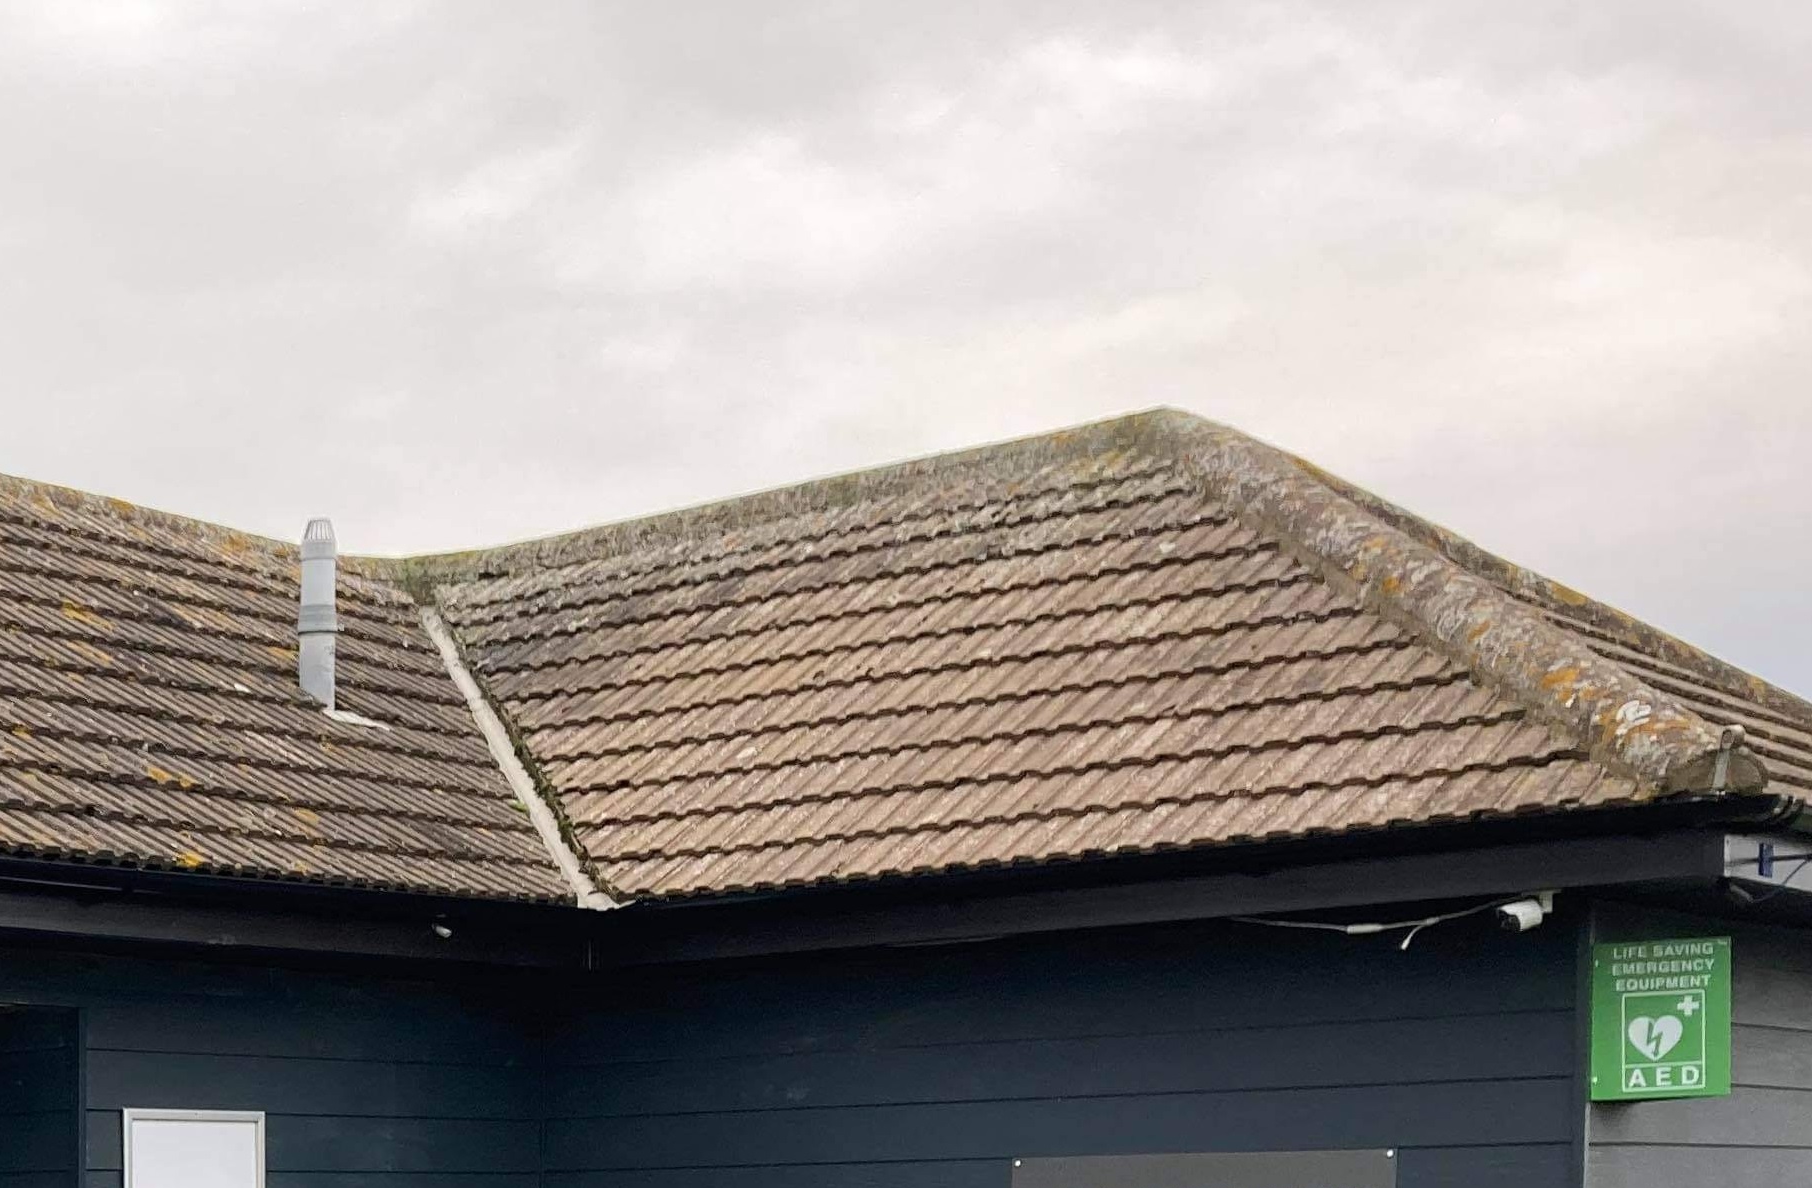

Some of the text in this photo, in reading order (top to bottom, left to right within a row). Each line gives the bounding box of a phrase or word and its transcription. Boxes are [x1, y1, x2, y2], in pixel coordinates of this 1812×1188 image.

[1613, 942, 1714, 959] LIFE SAVING
[1612, 958, 1715, 976] EMERGENCY
[1615, 975, 1711, 991] EQUIPMENT
[1628, 1066, 1700, 1087] AED
